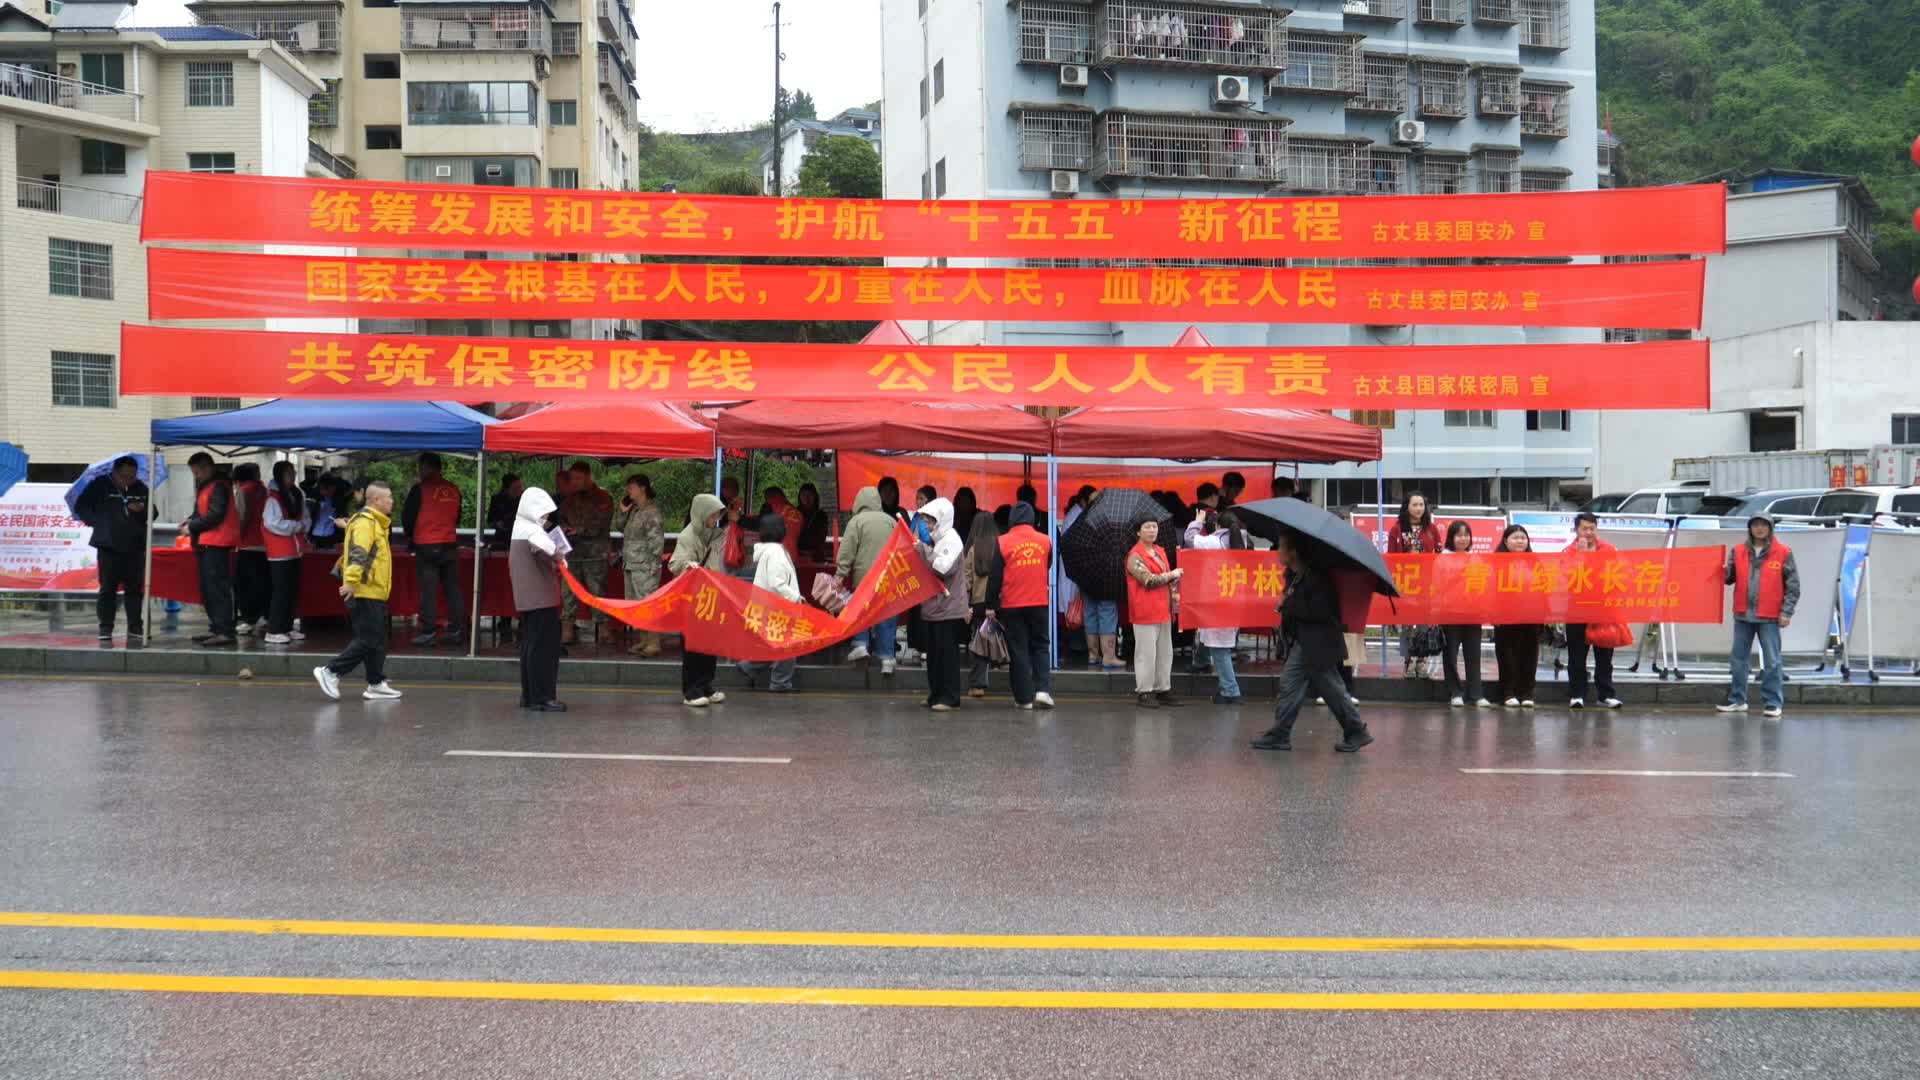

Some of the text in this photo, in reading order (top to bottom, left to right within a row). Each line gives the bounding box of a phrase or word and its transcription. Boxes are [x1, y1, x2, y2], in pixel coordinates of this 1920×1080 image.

[286, 340, 757, 392] 共筑保密防线
[868, 351, 1332, 396] 公民人人有责
[1354, 375, 1521, 397] 古丈县国家保密局
